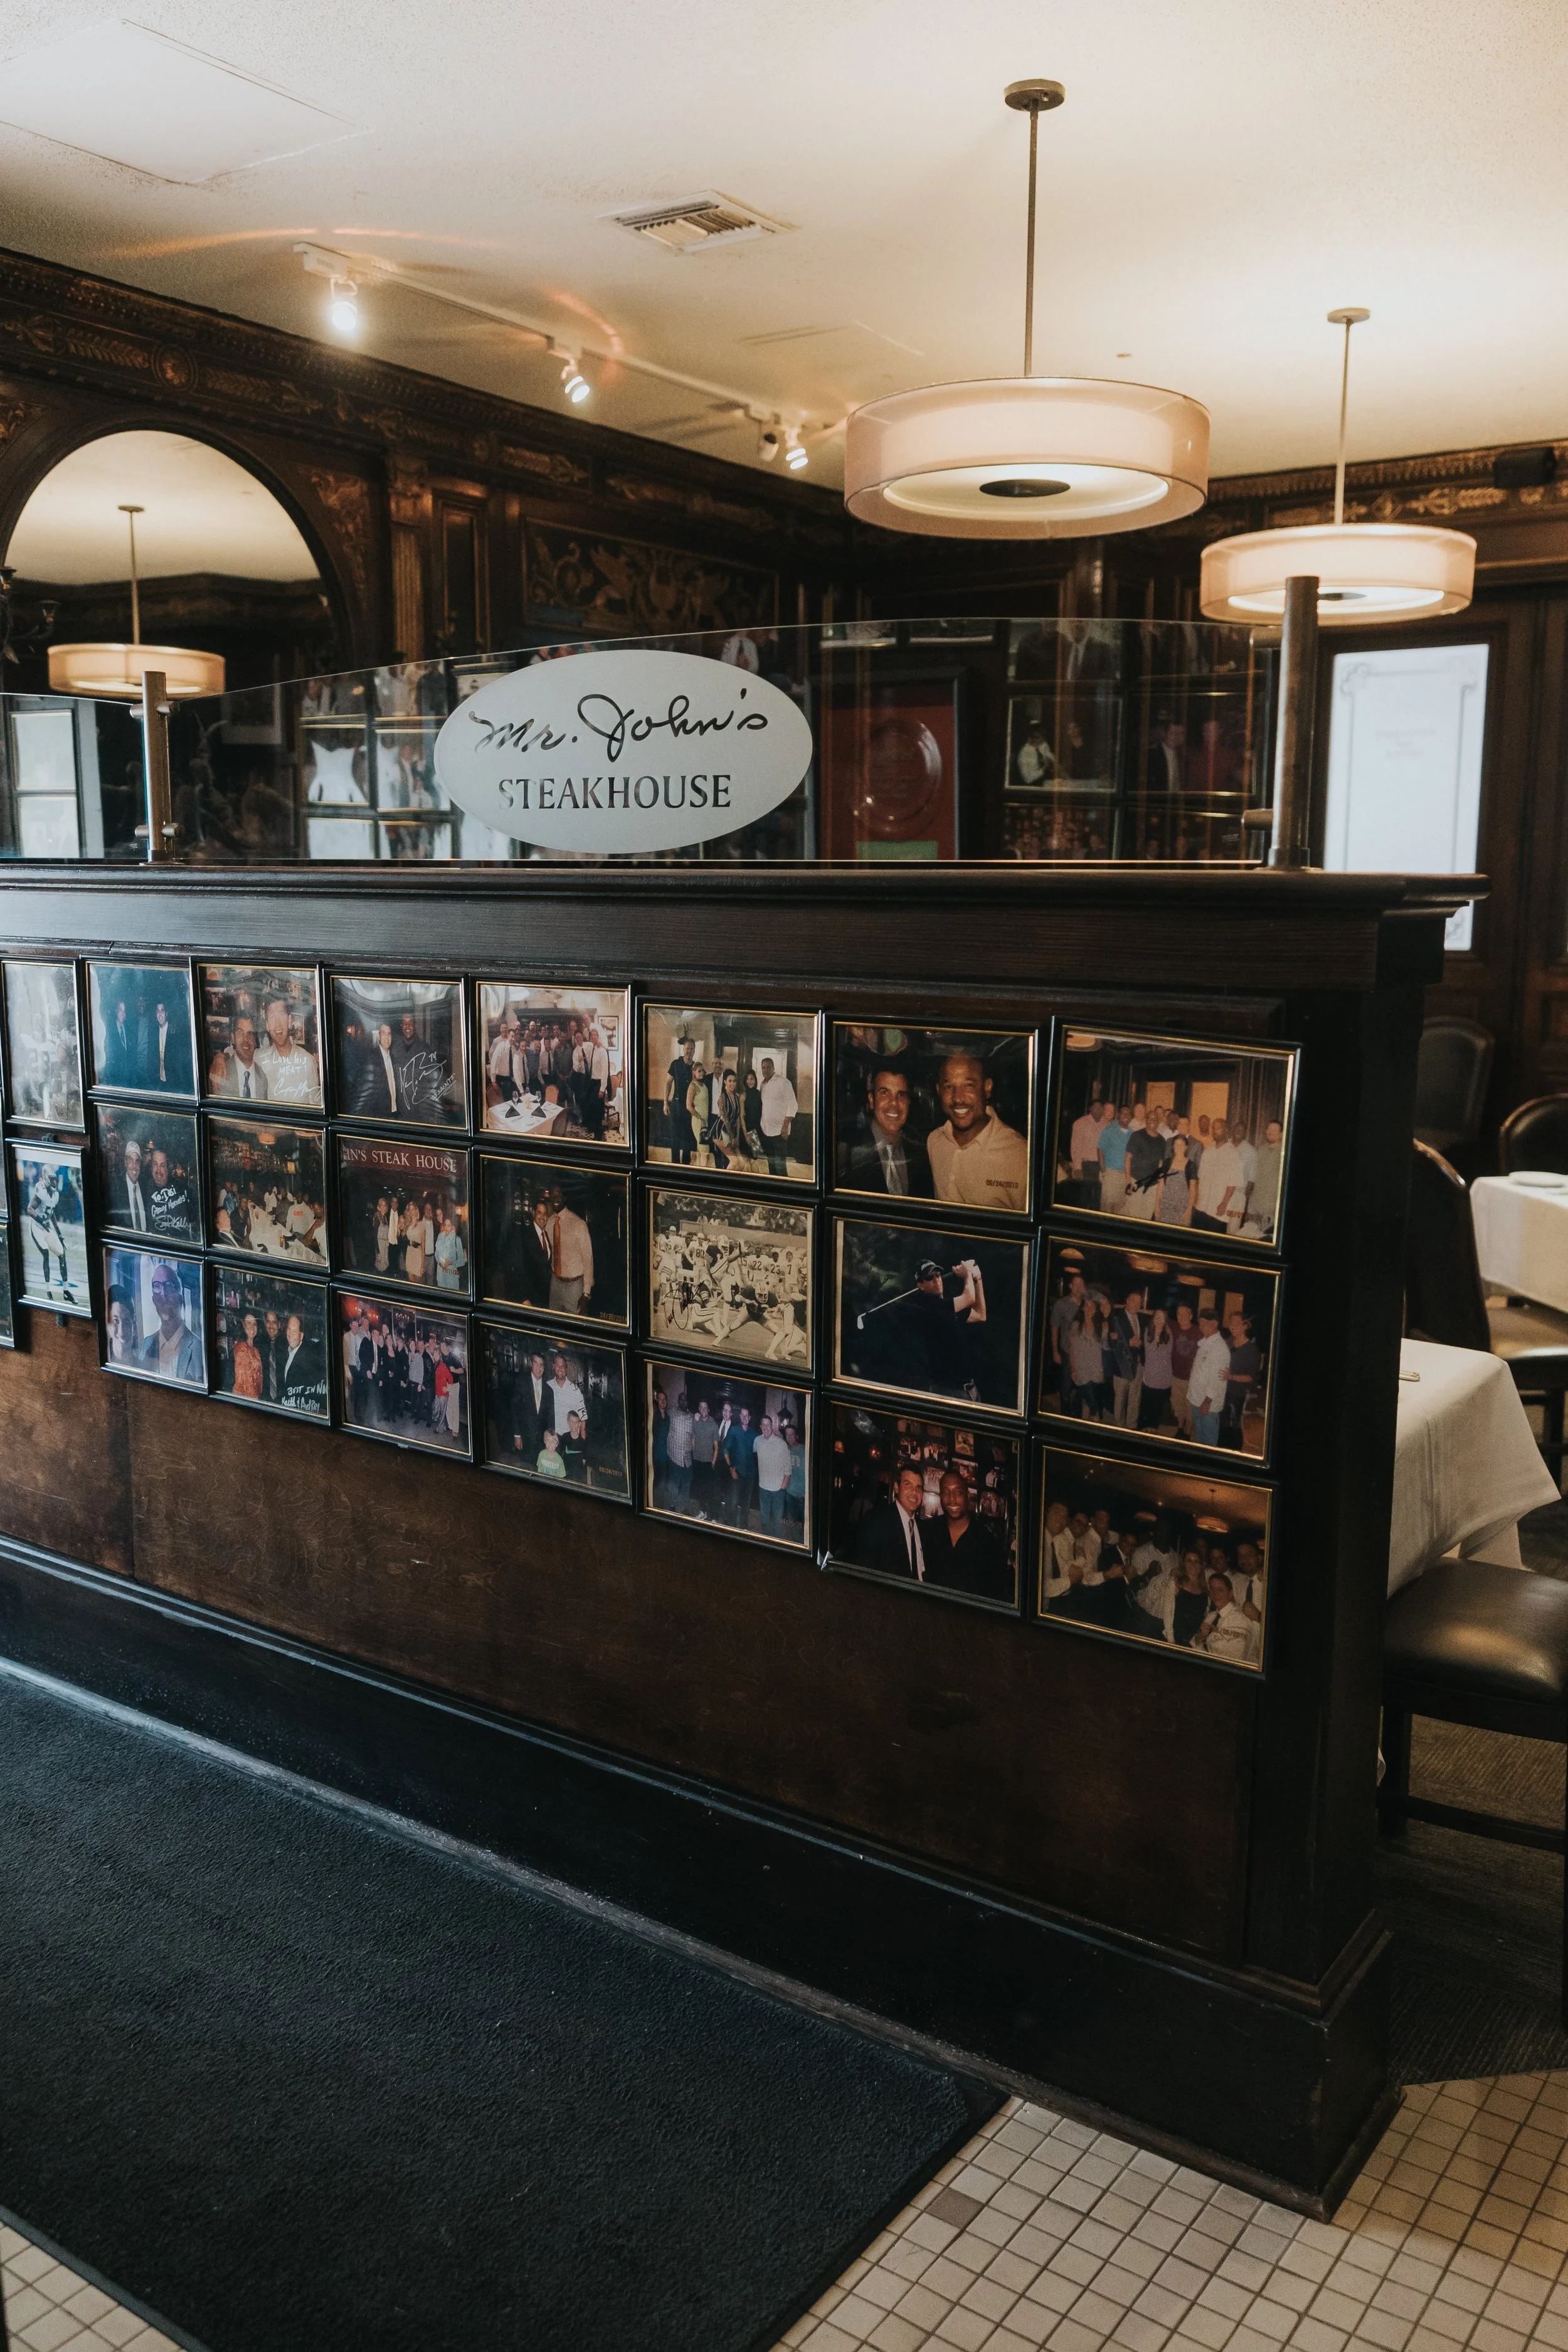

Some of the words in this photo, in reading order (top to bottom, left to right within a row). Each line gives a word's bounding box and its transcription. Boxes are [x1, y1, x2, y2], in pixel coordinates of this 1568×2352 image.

[469, 711, 578, 753] Mr.
[578, 688, 768, 762] John's
[498, 774, 731, 809] STEAKHOUSE
[371, 1150, 410, 1167] STEAK
[415, 1154, 457, 1173] HOUSE
[696, 1248, 705, 1259] 80
[753, 1260, 762, 1271] 22
[771, 1263, 780, 1274] 23
[787, 1264, 792, 1274] 7
